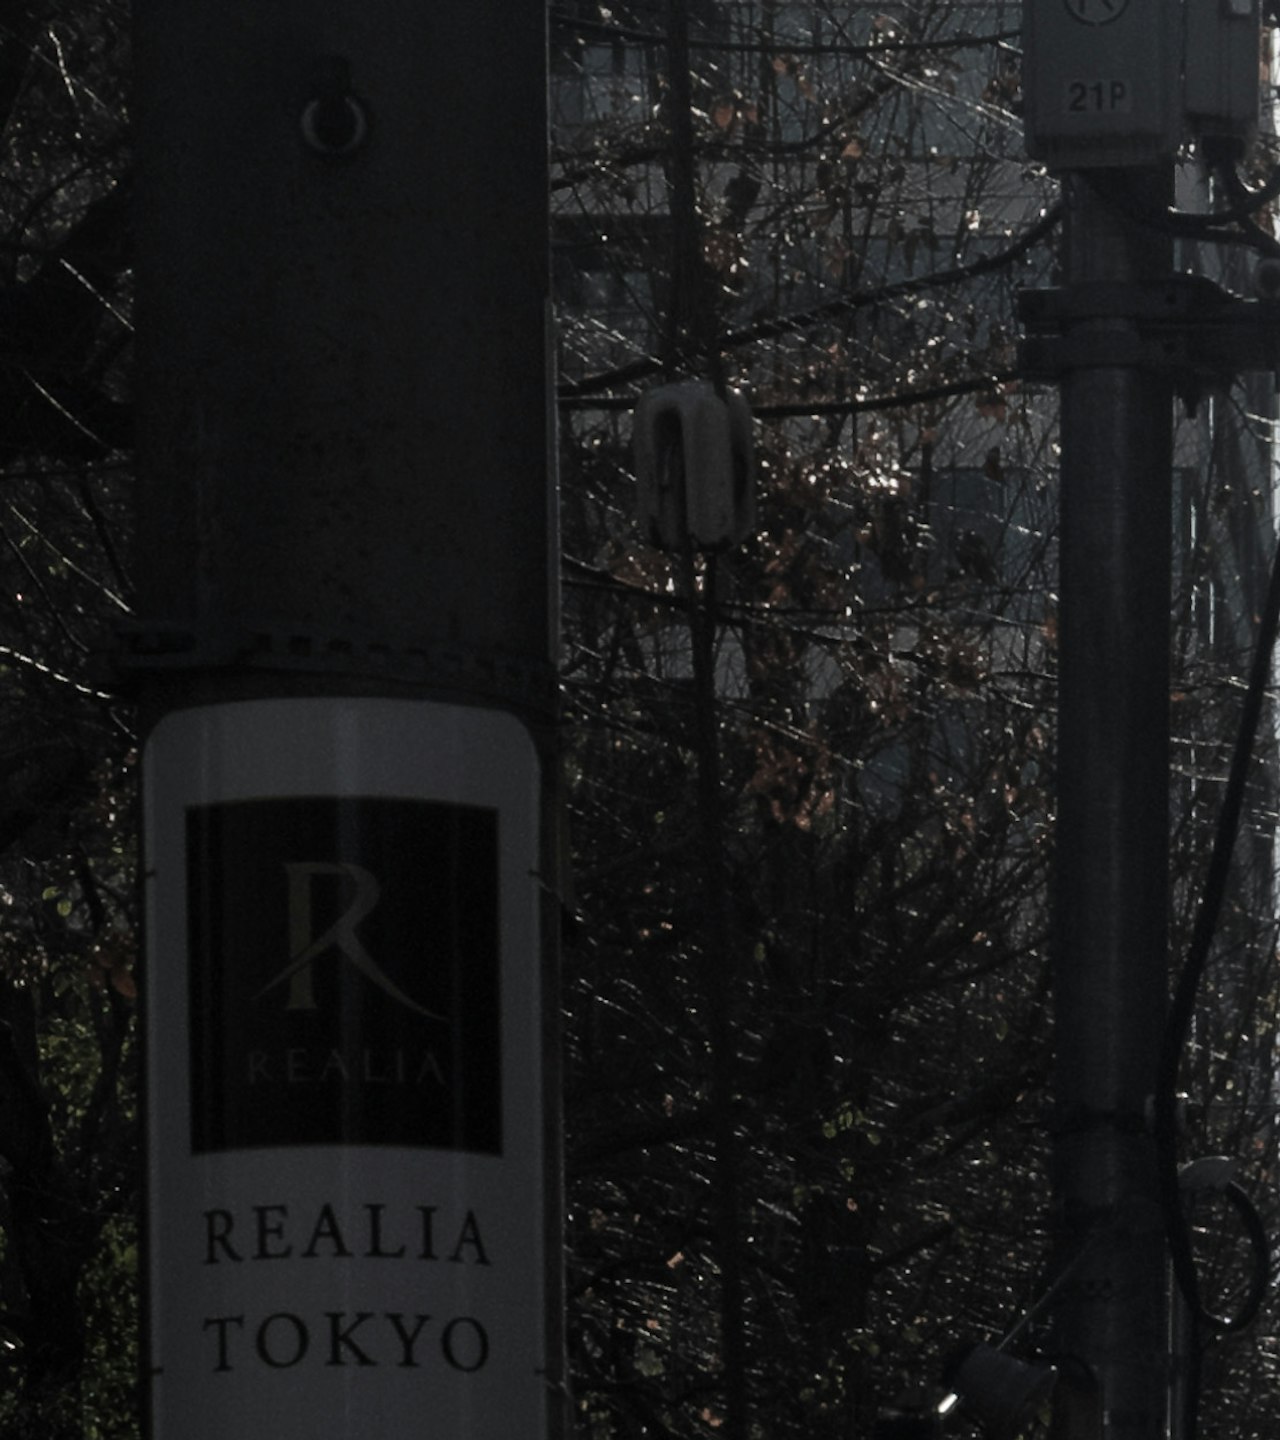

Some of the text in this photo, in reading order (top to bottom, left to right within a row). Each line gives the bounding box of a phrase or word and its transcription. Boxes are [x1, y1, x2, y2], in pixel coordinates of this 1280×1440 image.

[1069, 80, 1126, 112] 21P
[247, 1048, 448, 1086] REALIA
[202, 1203, 491, 1267] REALIA
[204, 1311, 490, 1373] TOKYO
